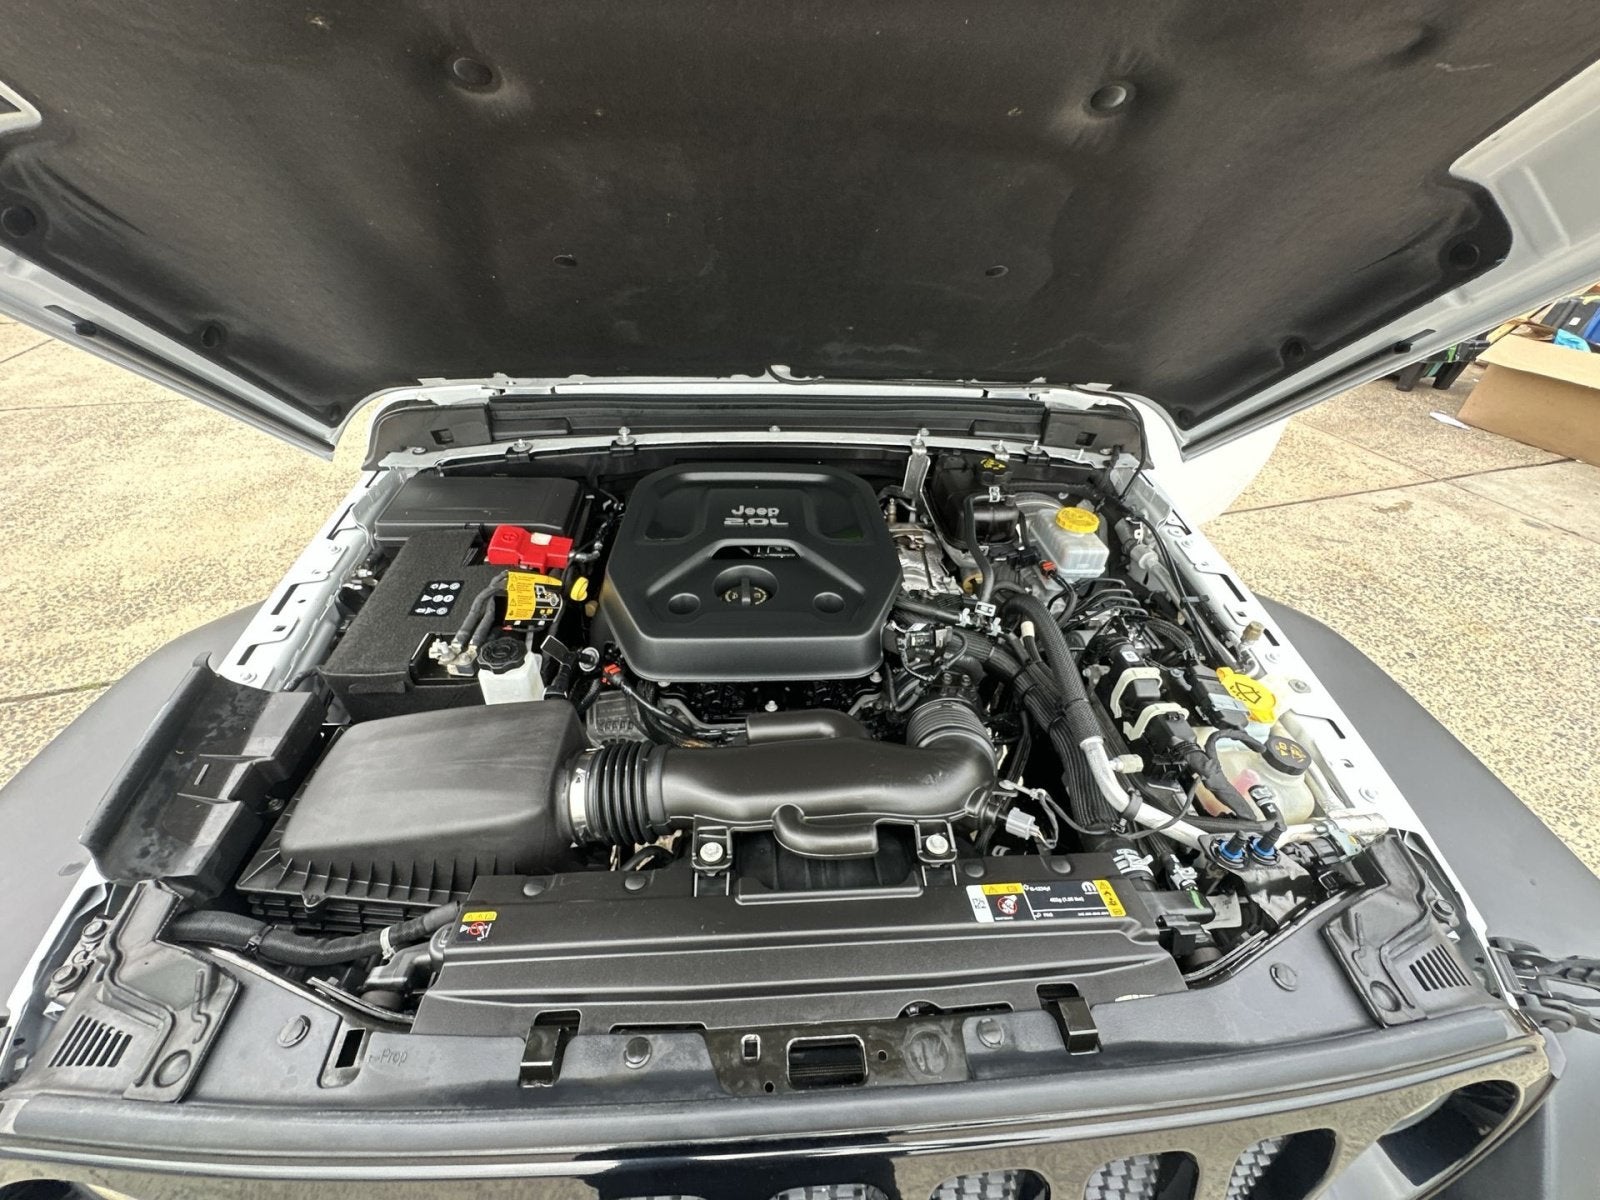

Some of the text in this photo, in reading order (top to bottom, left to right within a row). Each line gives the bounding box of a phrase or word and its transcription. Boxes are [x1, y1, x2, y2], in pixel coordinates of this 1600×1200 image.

[732, 505, 779, 516] Jeep
[723, 517, 789, 525] 2.0L
[380, 1047, 408, 1066] Prop
